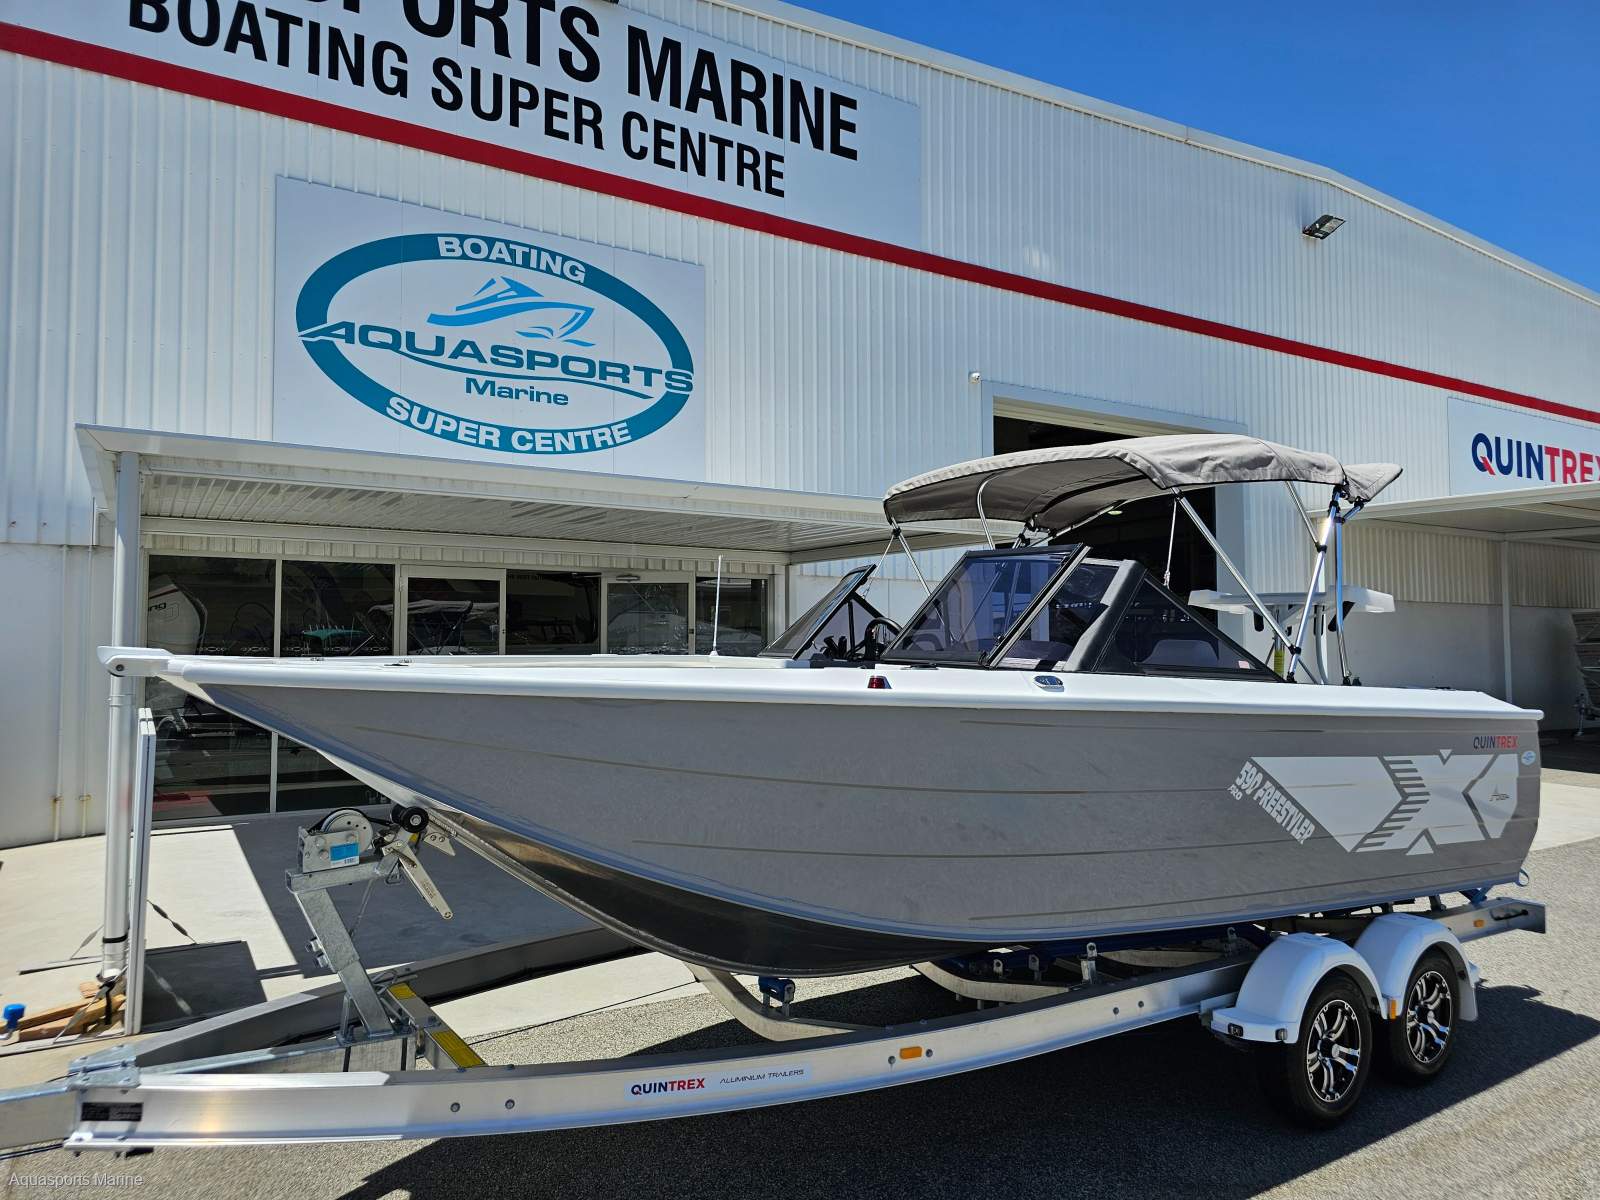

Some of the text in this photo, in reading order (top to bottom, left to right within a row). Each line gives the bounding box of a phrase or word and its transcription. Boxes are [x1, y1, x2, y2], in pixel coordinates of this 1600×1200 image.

[129, 0, 785, 198] BOATING SUPER CENTRE
[307, 0, 858, 161] ORTS MARINE
[436, 236, 587, 284] BOATING
[298, 321, 694, 394] AQUASPORTS
[465, 377, 570, 406] Marine
[385, 396, 632, 452] SUPER CENTRE
[1471, 432, 1600, 485] QUINTRE
[1473, 735, 1519, 750] QUINTREX
[1235, 761, 1316, 845] 590 FREESTYLER
[631, 1069, 805, 1096] QUINTREX ALUMINIUM TRAILERS
